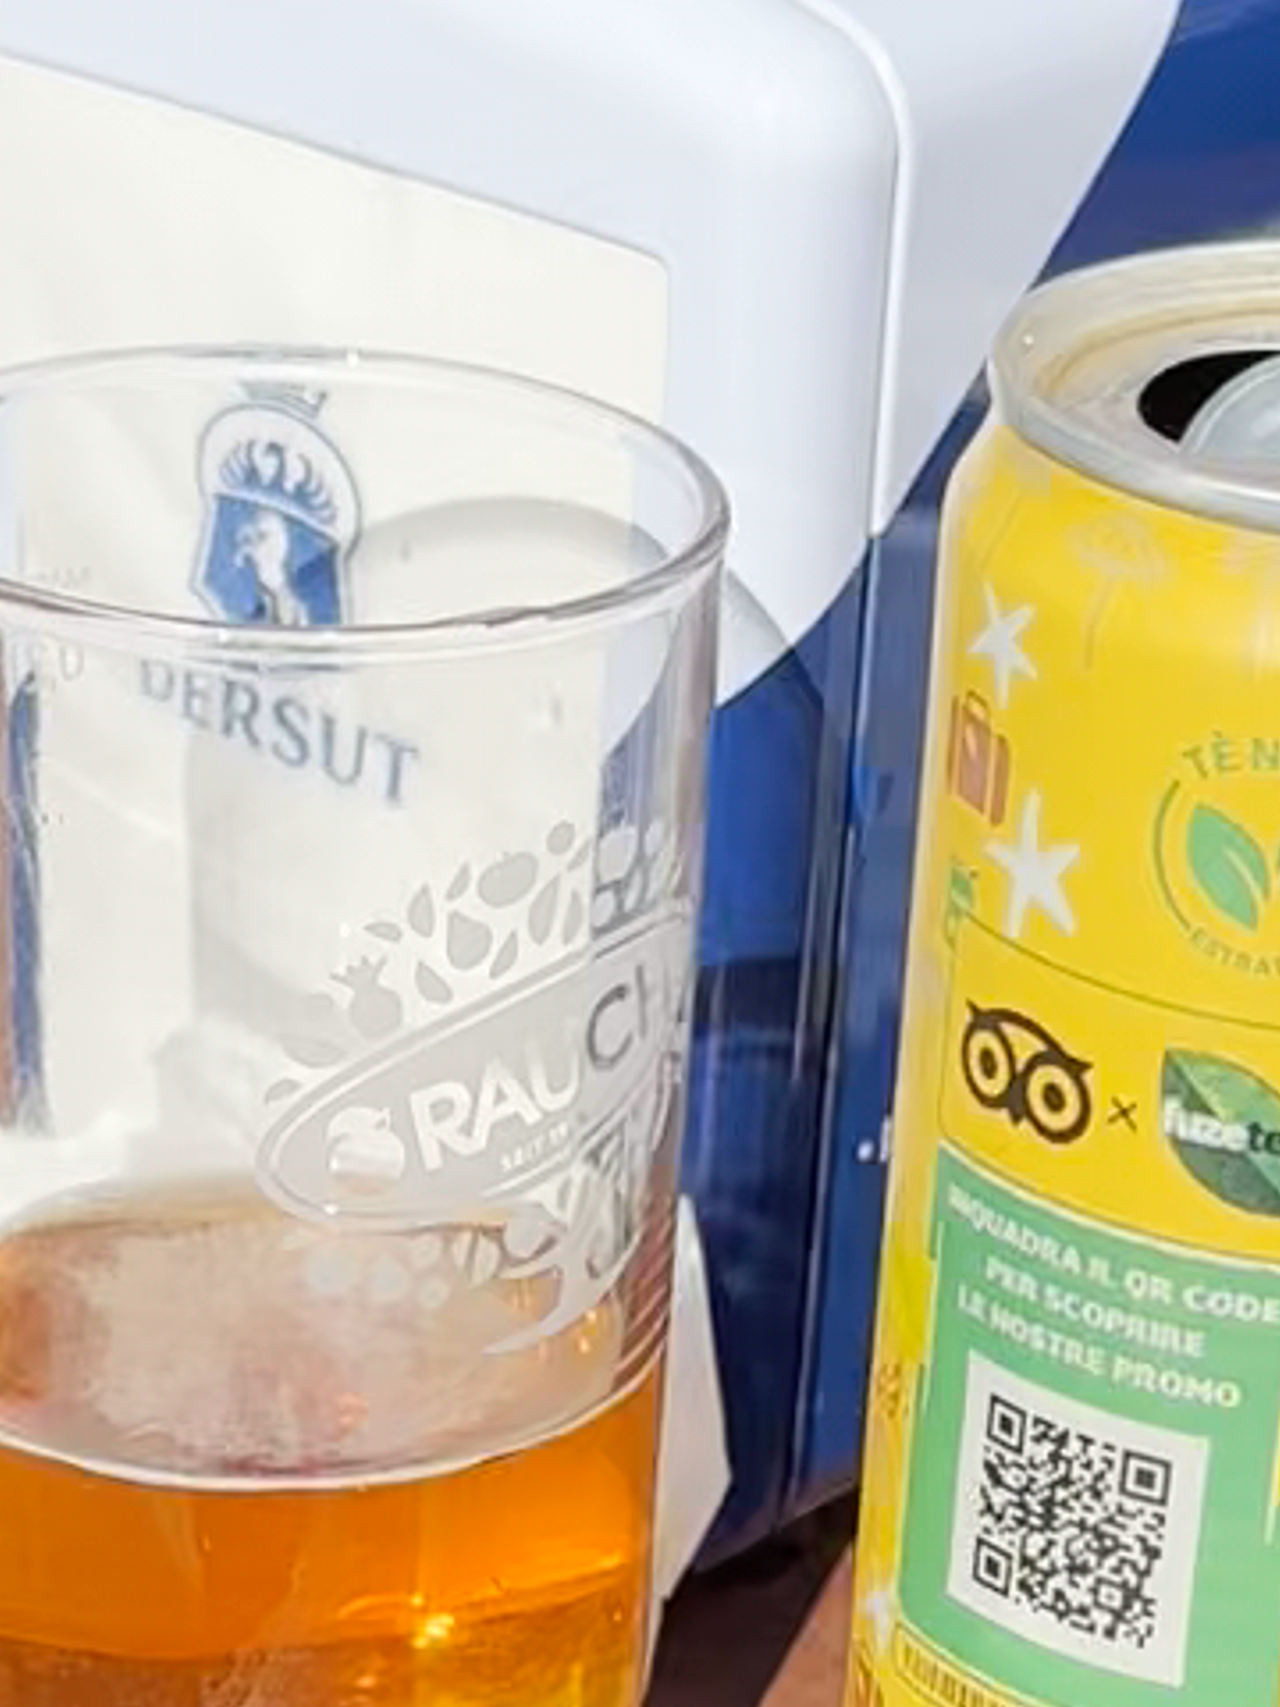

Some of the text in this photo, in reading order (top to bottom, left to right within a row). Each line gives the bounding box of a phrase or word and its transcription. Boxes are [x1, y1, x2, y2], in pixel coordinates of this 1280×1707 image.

[141, 657, 420, 810] DERSUT
[1181, 730, 1243, 780] TÈ
[985, 1254, 1208, 1359] PER SCOPRIRE
[1086, 1252, 1114, 1286] IL
[1124, 1269, 1174, 1305] QR
[957, 1283, 1243, 1410] LE NOSTRE PROMO
